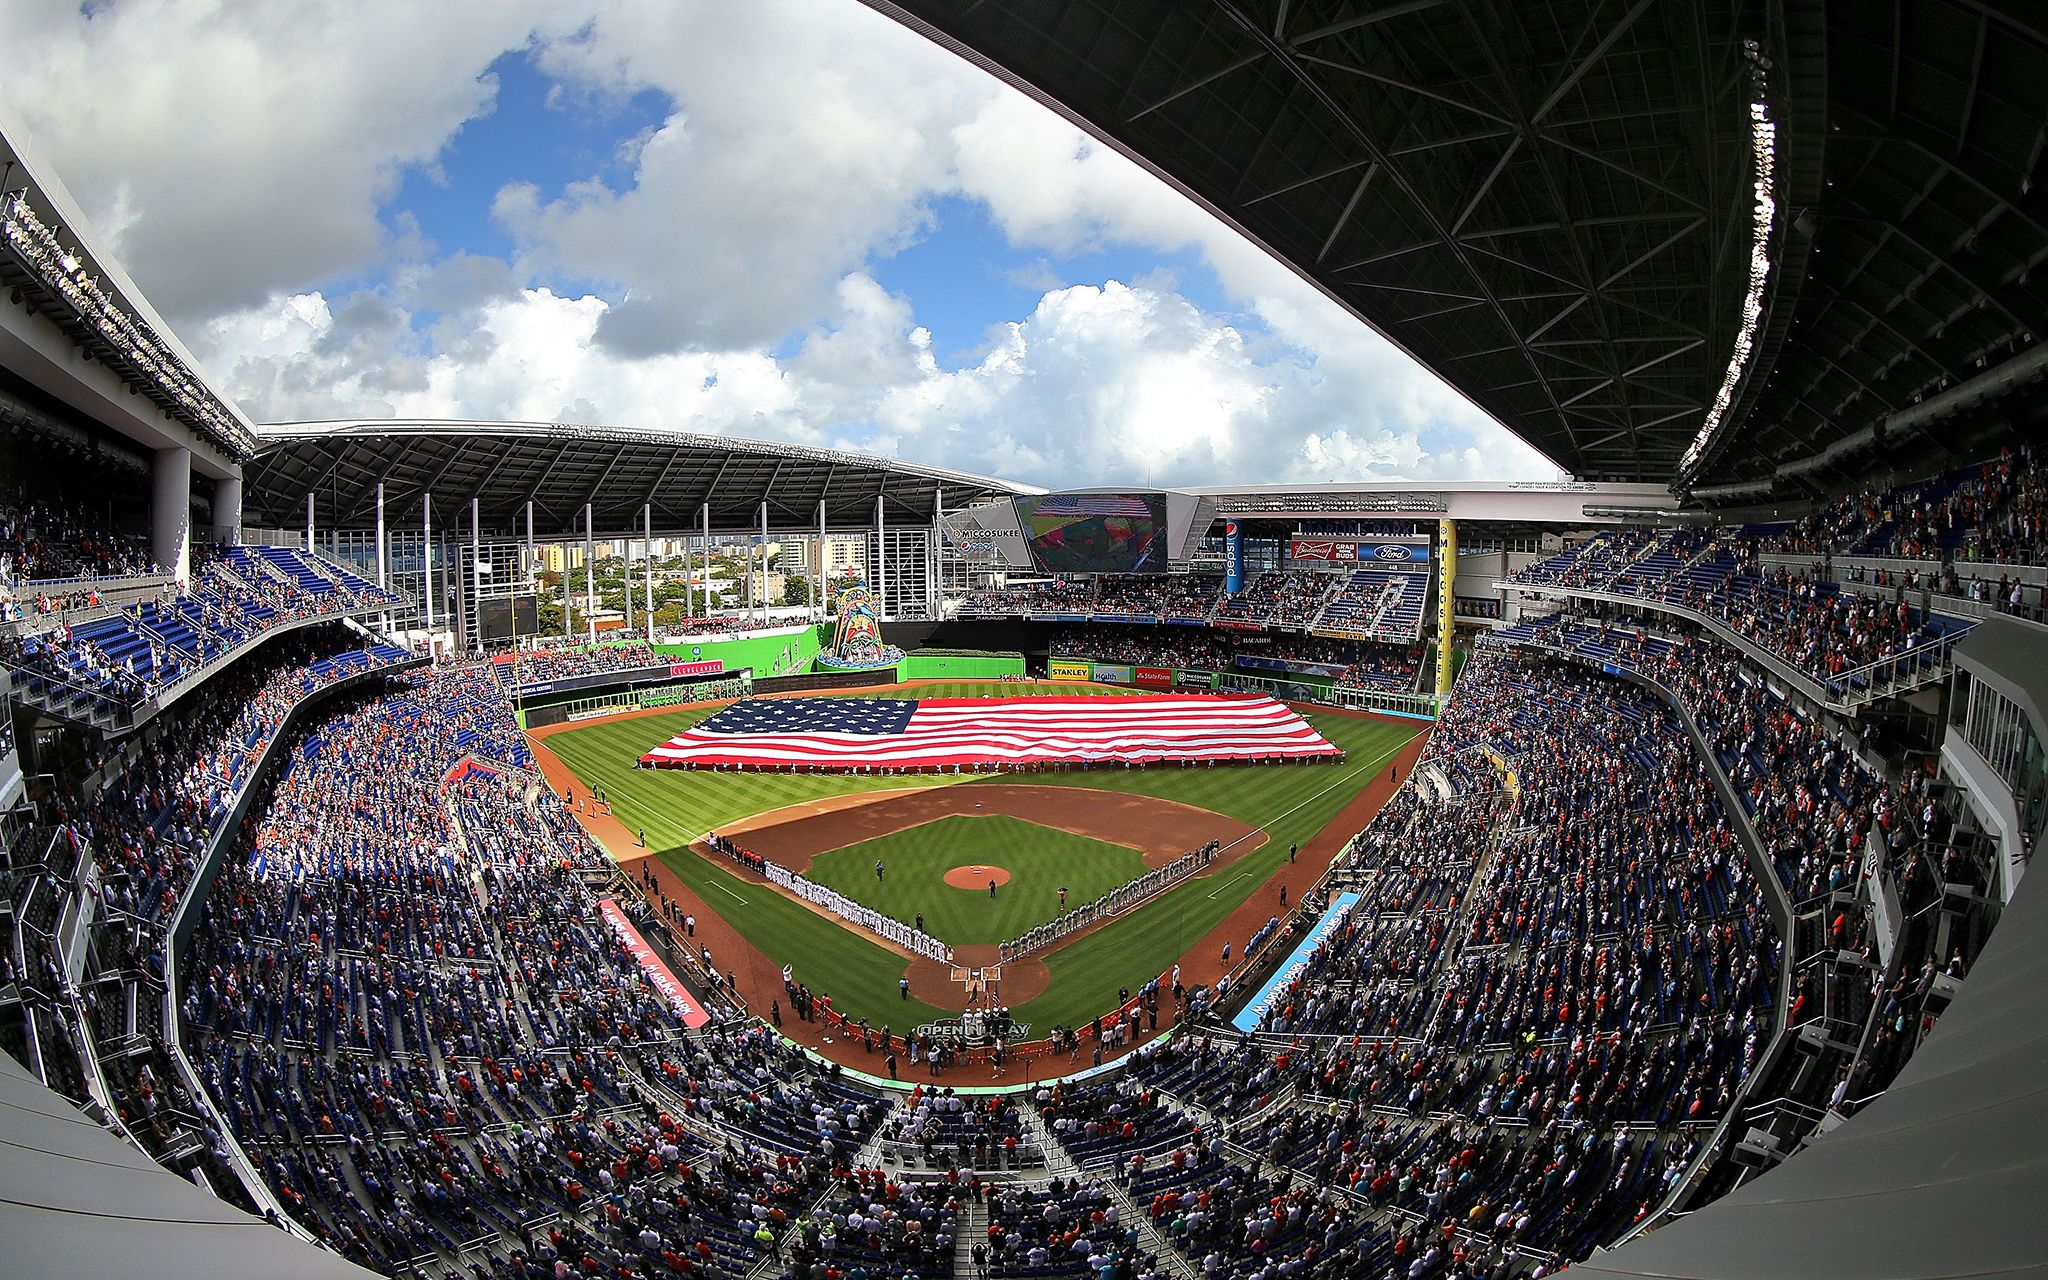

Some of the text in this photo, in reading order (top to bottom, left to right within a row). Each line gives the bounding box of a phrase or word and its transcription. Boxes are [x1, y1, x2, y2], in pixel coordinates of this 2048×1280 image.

[962, 529, 1019, 537] MICCOSUKEE
[1302, 524, 1412, 536] MARLINS PARK
[970, 542, 997, 551] pepsi
[1296, 545, 1331, 554] Budweiser
[1227, 541, 1236, 576] pepsi
[1380, 547, 1404, 559] Ford
[1437, 539, 1447, 672] MICCOSUKEE
[680, 616, 741, 627] Budweiser
[672, 664, 721, 674] CLEVELANDER
[1052, 668, 1088, 676] STANLEY
[1283, 960, 1304, 983] PARK
[645, 964, 695, 1016] MARLINS PARK
